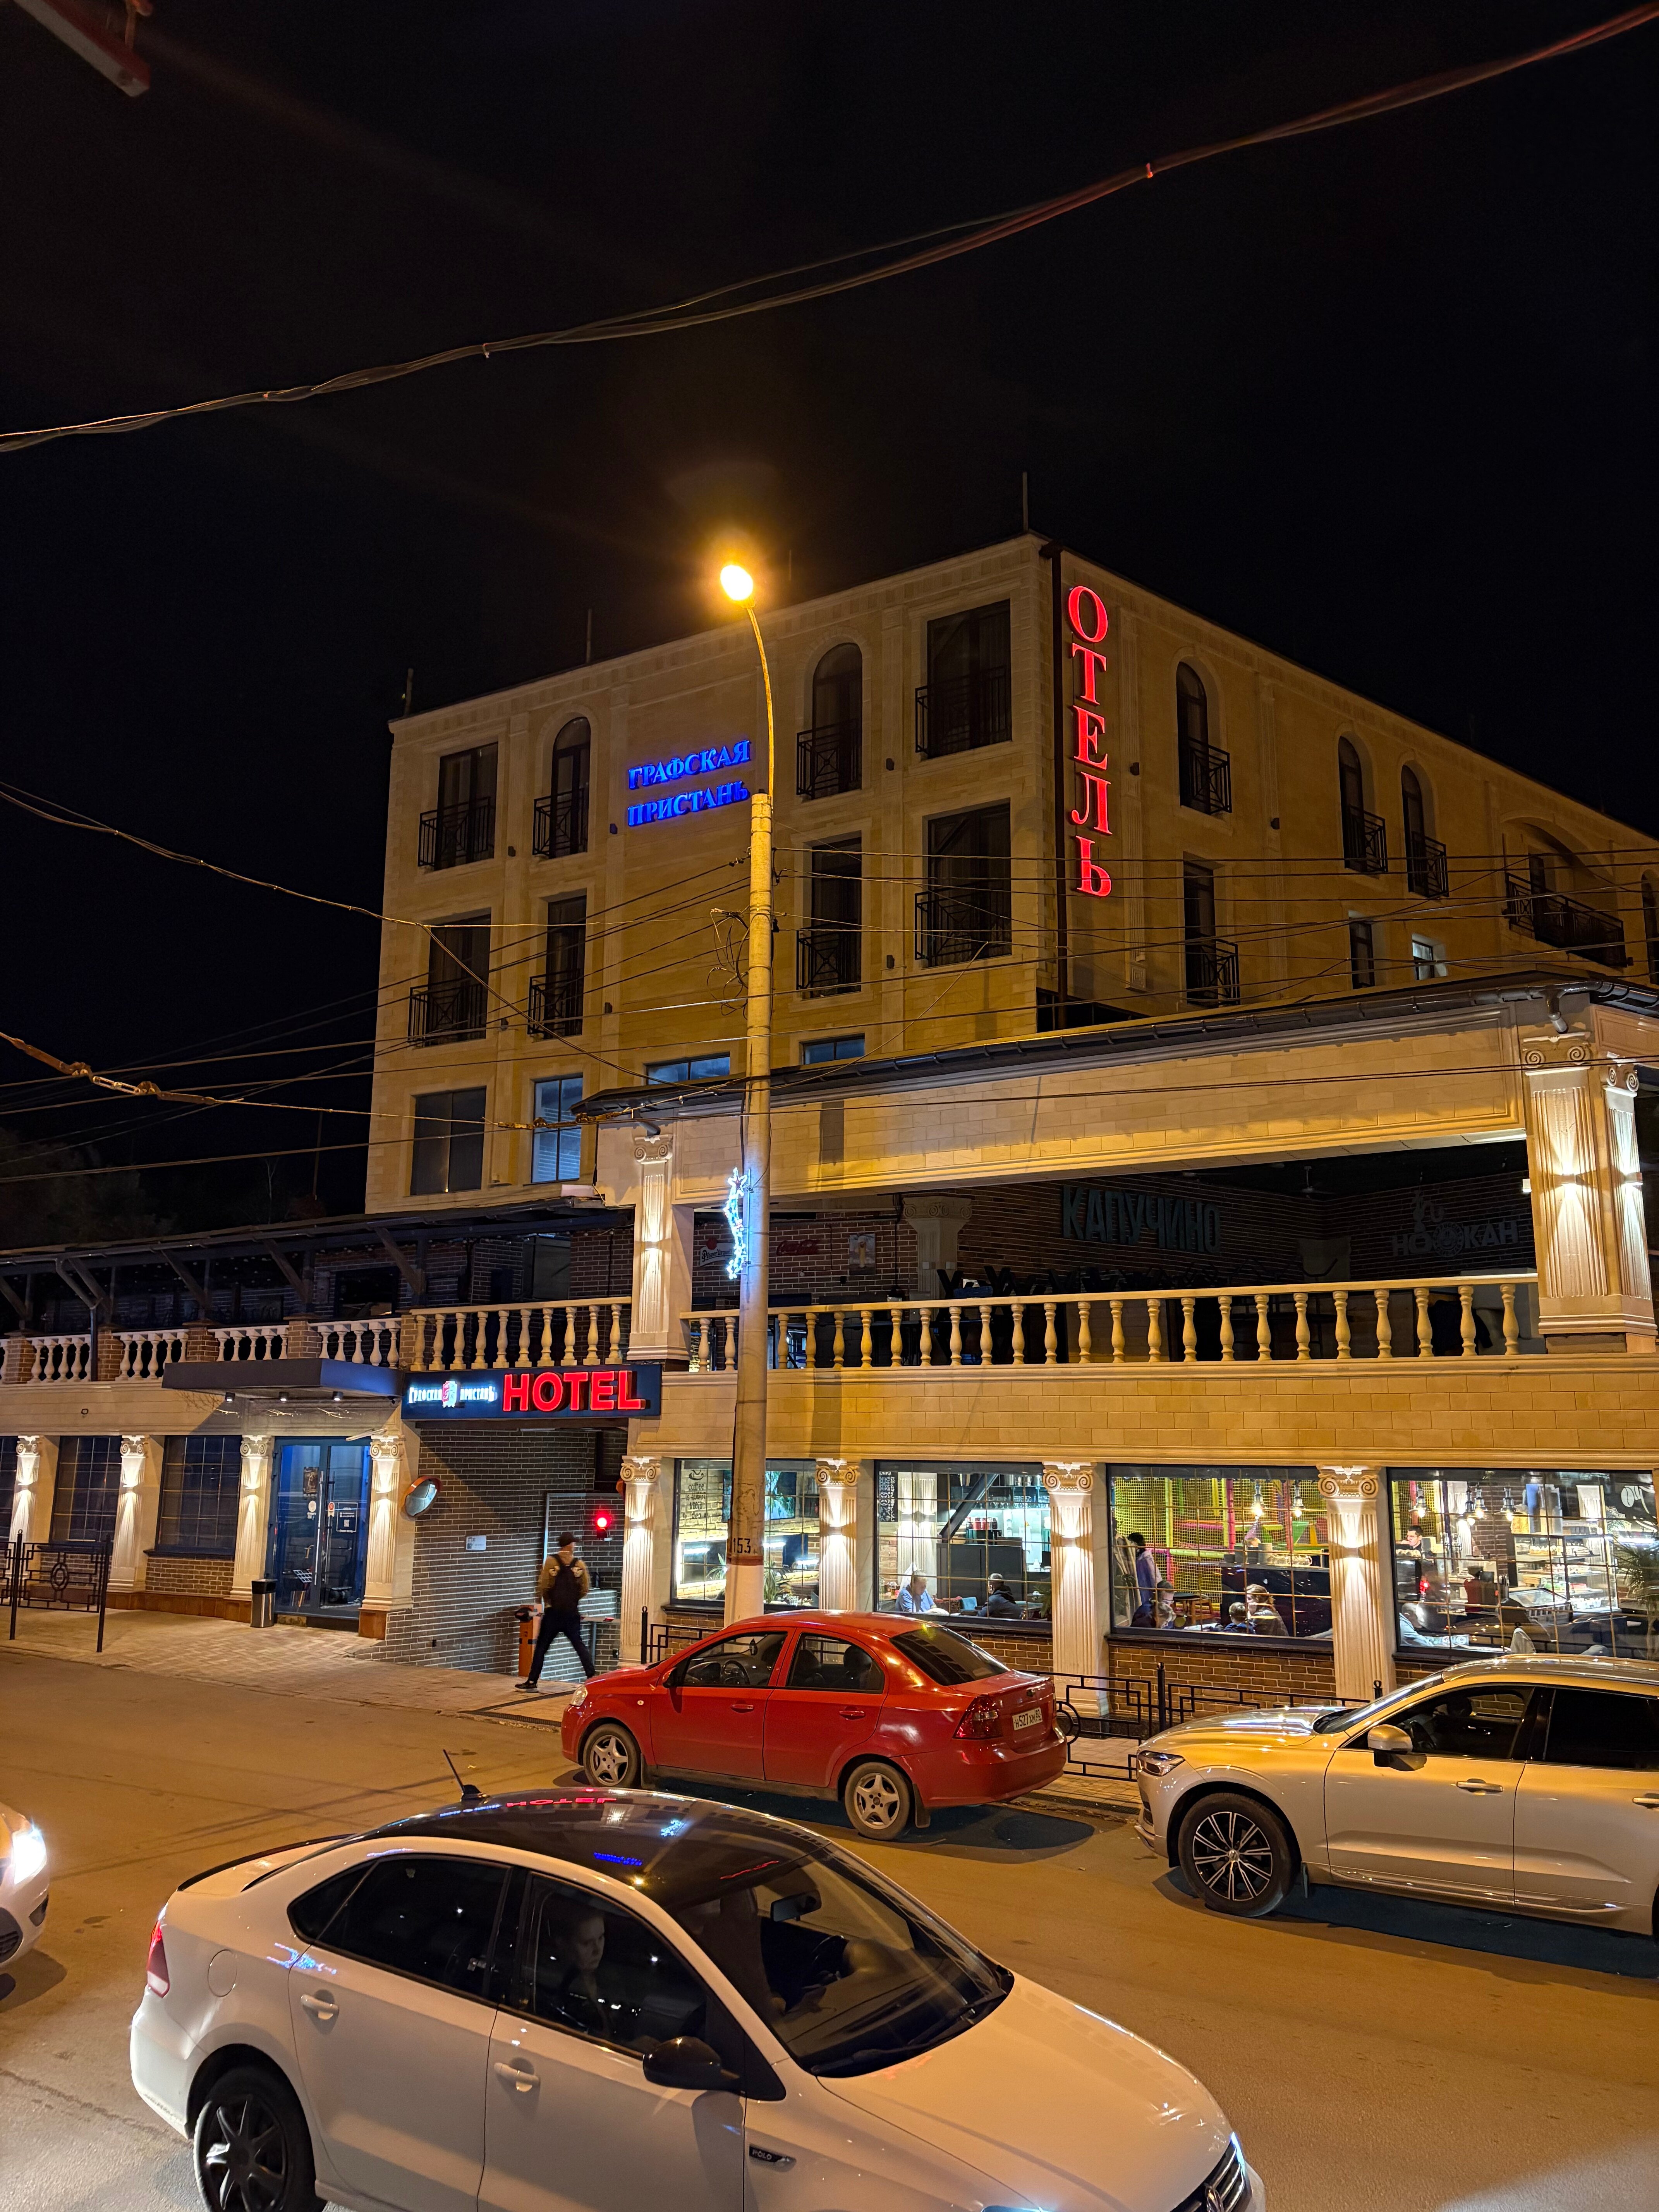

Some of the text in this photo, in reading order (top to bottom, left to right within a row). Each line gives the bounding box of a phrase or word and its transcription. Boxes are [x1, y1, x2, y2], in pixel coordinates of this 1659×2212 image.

[1068, 585, 1113, 897] ОТЕЛЬ
[628, 740, 750, 789] ГРАФСКАЯ
[628, 780, 750, 826] ПРИСТАНЬ
[1062, 1185, 1221, 1254] КАПУЧИНО
[503, 1370, 641, 1412] HOTEL
[688, 1482, 704, 1491] coffee
[733, 1537, 751, 1553] 153
[752, 2149, 772, 2160] POLO
